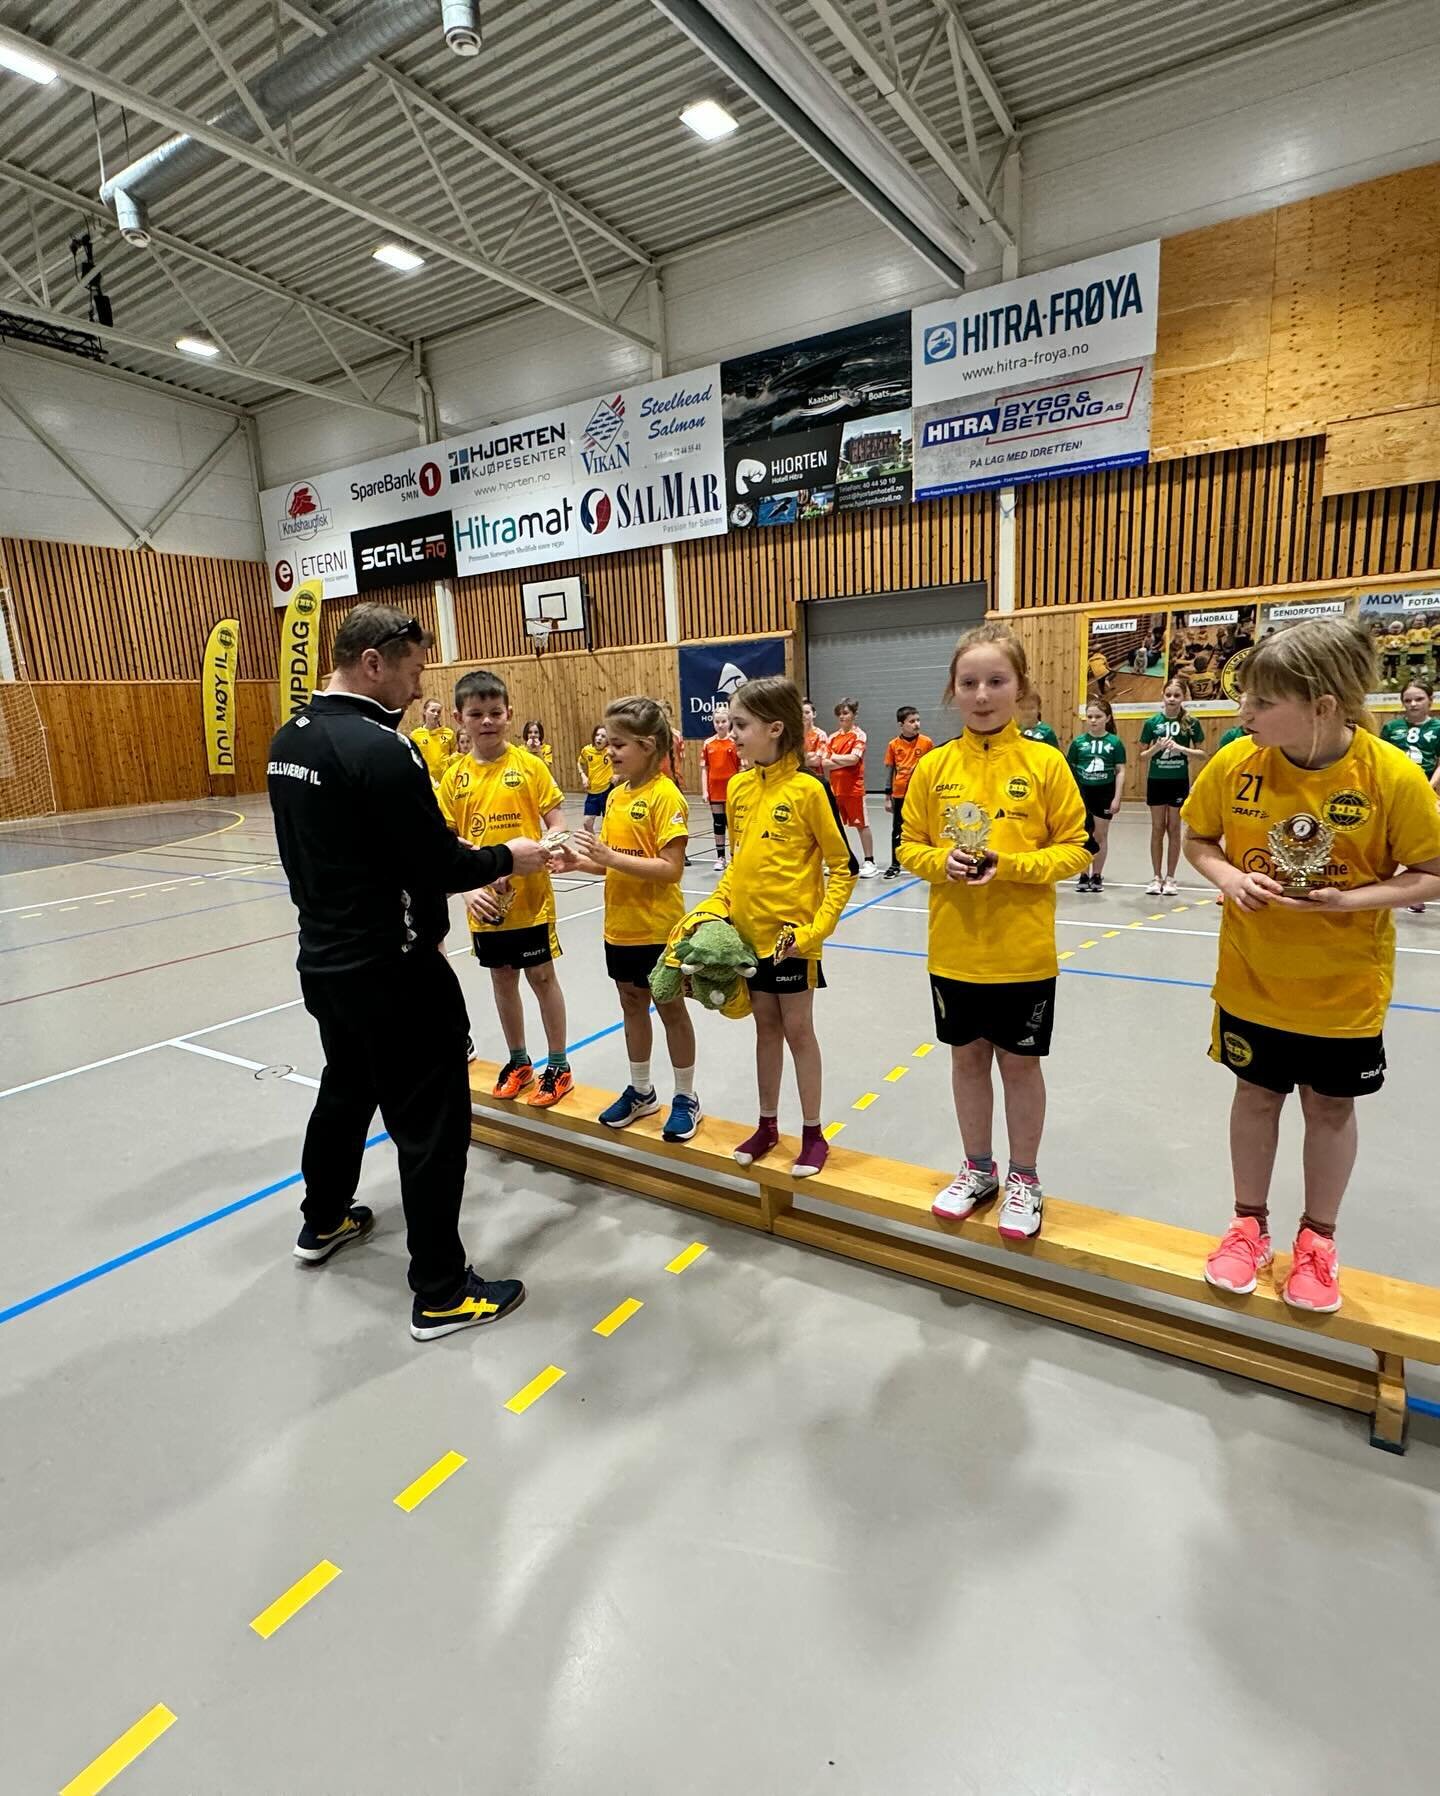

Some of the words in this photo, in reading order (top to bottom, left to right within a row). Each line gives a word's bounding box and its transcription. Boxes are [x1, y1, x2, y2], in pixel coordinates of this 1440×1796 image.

[962, 342, 1089, 381] www.hitra-froya.no
[640, 384, 713, 418] Steelhead
[1004, 394, 1070, 418] BYGG
[1076, 391, 1091, 402] &
[648, 416, 706, 440] Salmon
[928, 414, 994, 443] HITRA
[1002, 400, 1104, 433] BETONG
[1104, 402, 1123, 412] AS
[469, 422, 566, 463] HJORTEN
[984, 455, 1005, 466] LAG
[1006, 450, 1028, 463] MED
[1030, 441, 1083, 458] IDRETTEN!
[471, 446, 566, 478] KJØPESENTER
[771, 450, 828, 476] HJORTEN
[350, 468, 417, 502] SpareBank
[424, 467, 435, 491] 1
[401, 489, 419, 502] SMN
[473, 472, 551, 497] www.hjorten.no
[455, 497, 575, 552] Hitramat
[301, 550, 348, 577] ETERNI
[1273, 605, 1342, 617] SENIORFOTBALL
[1095, 622, 1134, 631] ALLIDRETT
[215, 652, 228, 669] IL
[1090, 741, 1104, 754] 11
[1407, 727, 1420, 743] 8
[1236, 774, 1263, 803] 21
[489, 812, 521, 823] Hemne
